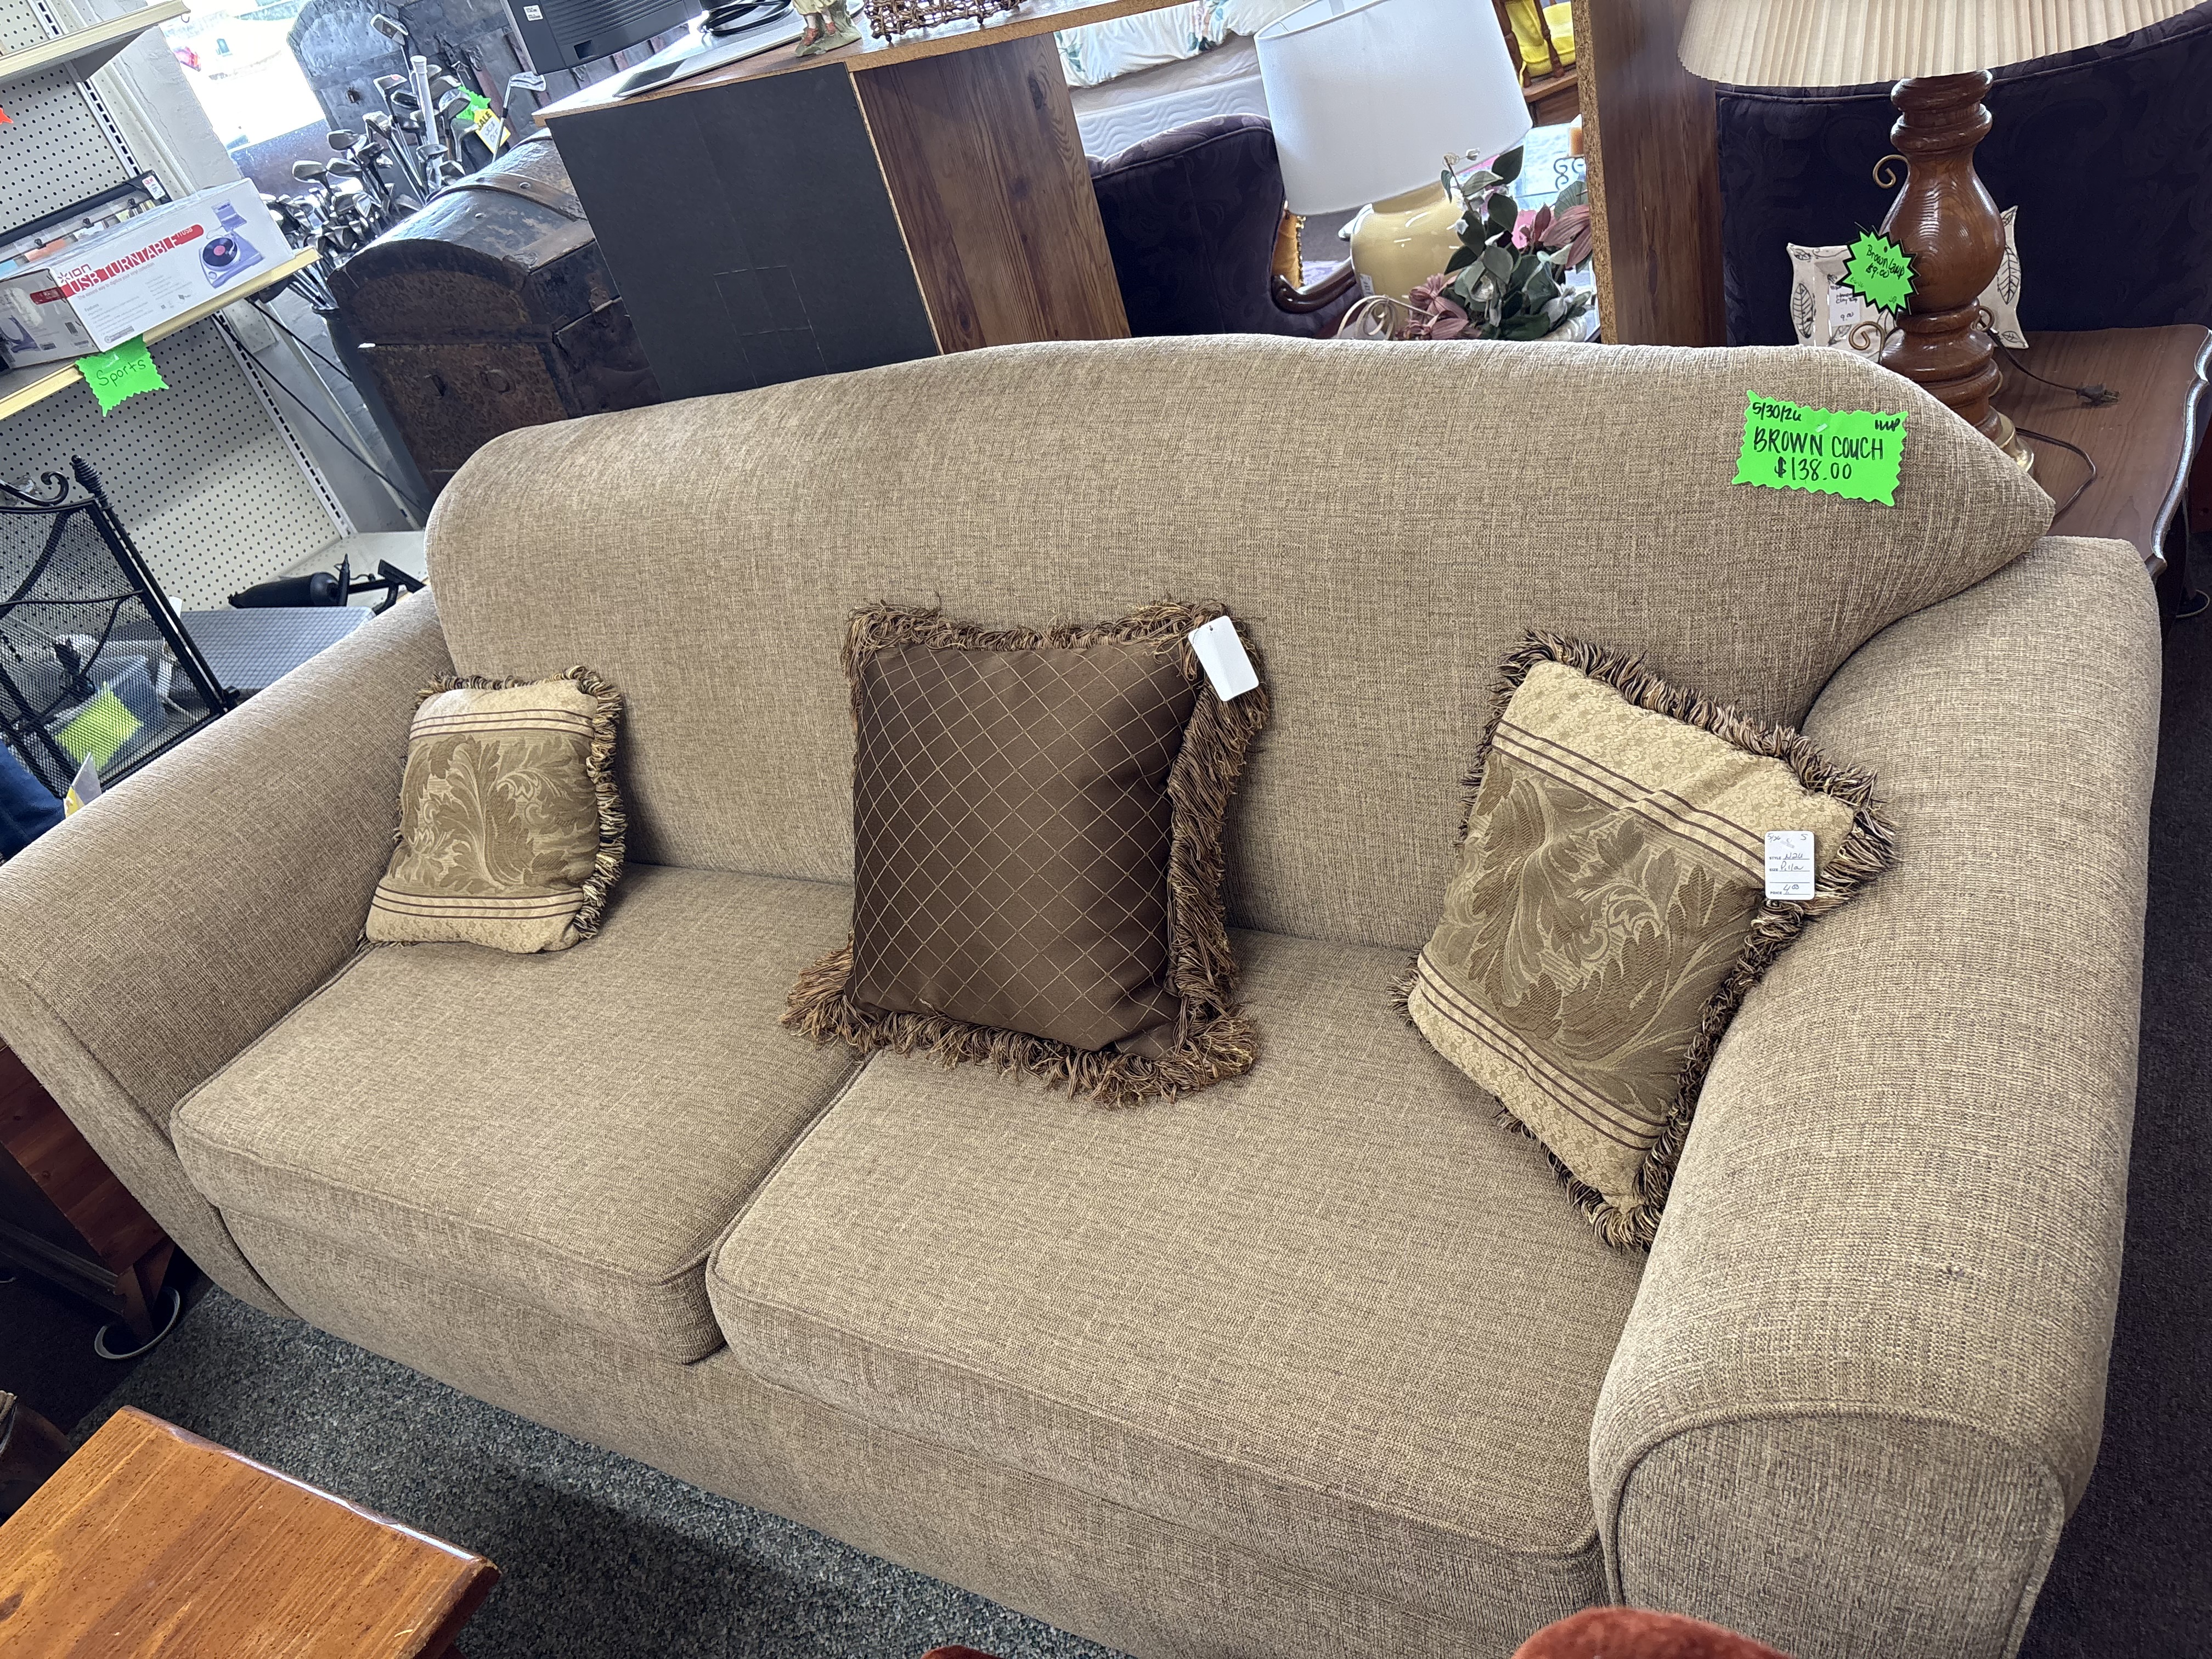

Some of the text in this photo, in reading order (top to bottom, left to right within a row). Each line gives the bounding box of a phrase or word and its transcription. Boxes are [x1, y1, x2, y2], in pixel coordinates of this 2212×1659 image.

[70, 234, 182, 294] USB TURNTABLE
[1866, 244, 1905, 280] Brown Lamp
[97, 359, 146, 387] Sports
[1753, 426, 1883, 460] BROWN COUCH
[1774, 456, 1852, 481] $138.00
